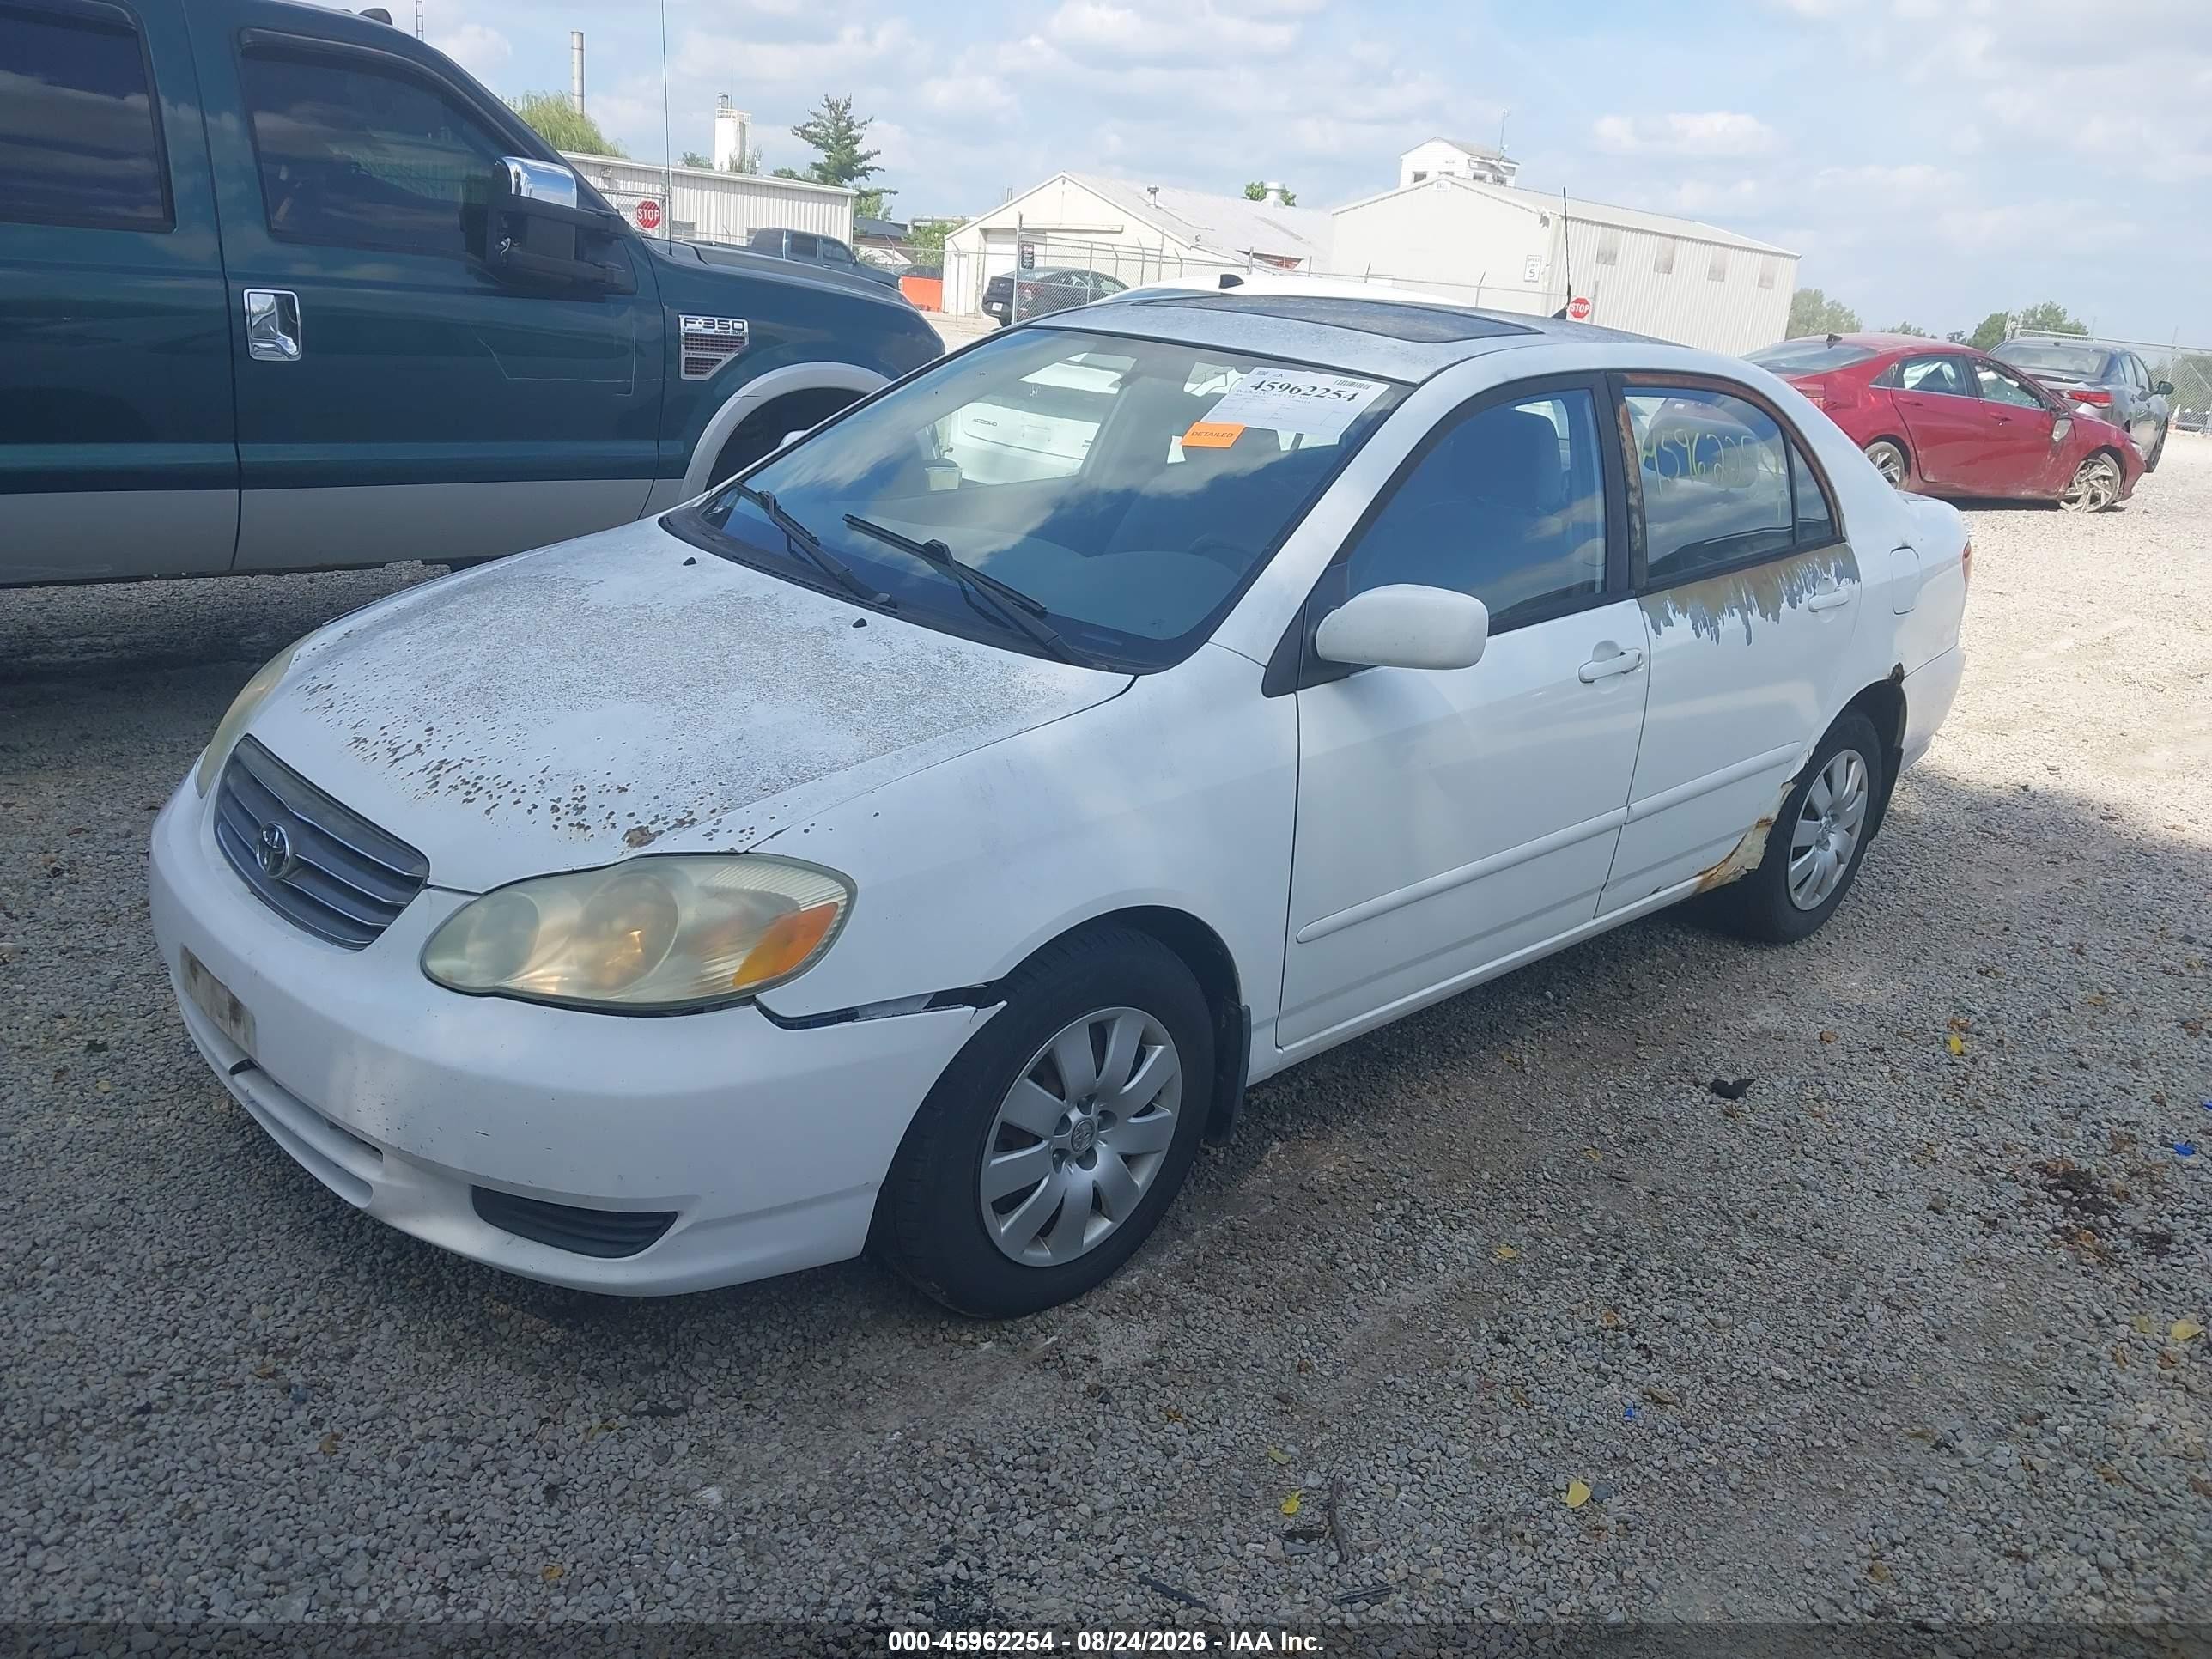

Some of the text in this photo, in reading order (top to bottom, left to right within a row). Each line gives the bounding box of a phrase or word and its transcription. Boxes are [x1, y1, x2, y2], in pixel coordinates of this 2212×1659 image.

[638, 209, 660, 221] STOP
[1528, 269, 1535, 278] 5
[1571, 303, 1591, 313] STOP
[1250, 380, 1359, 402] 45962254
